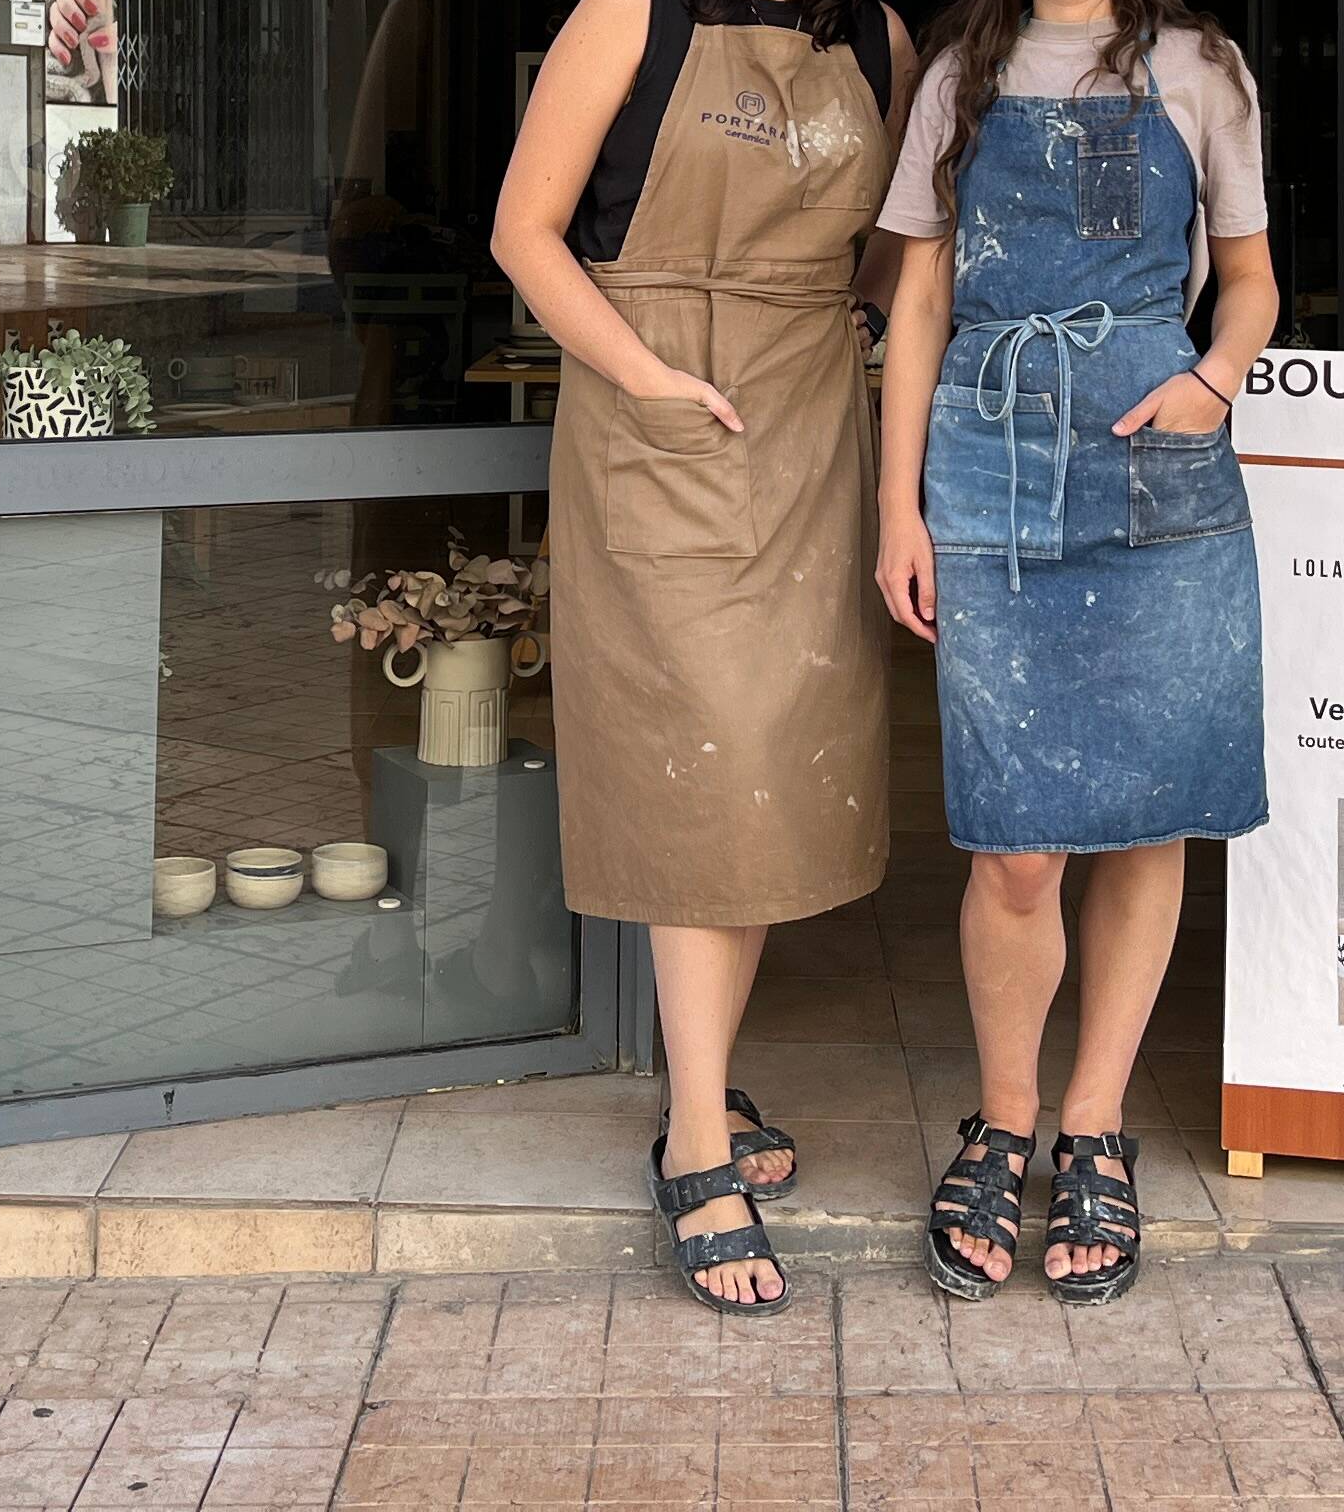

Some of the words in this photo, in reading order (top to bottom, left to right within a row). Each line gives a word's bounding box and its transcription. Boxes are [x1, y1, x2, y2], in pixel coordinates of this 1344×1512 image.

[701, 112, 788, 143] PORTARA
[725, 130, 770, 145] ceramics
[1294, 558, 1342, 578] LOLA
